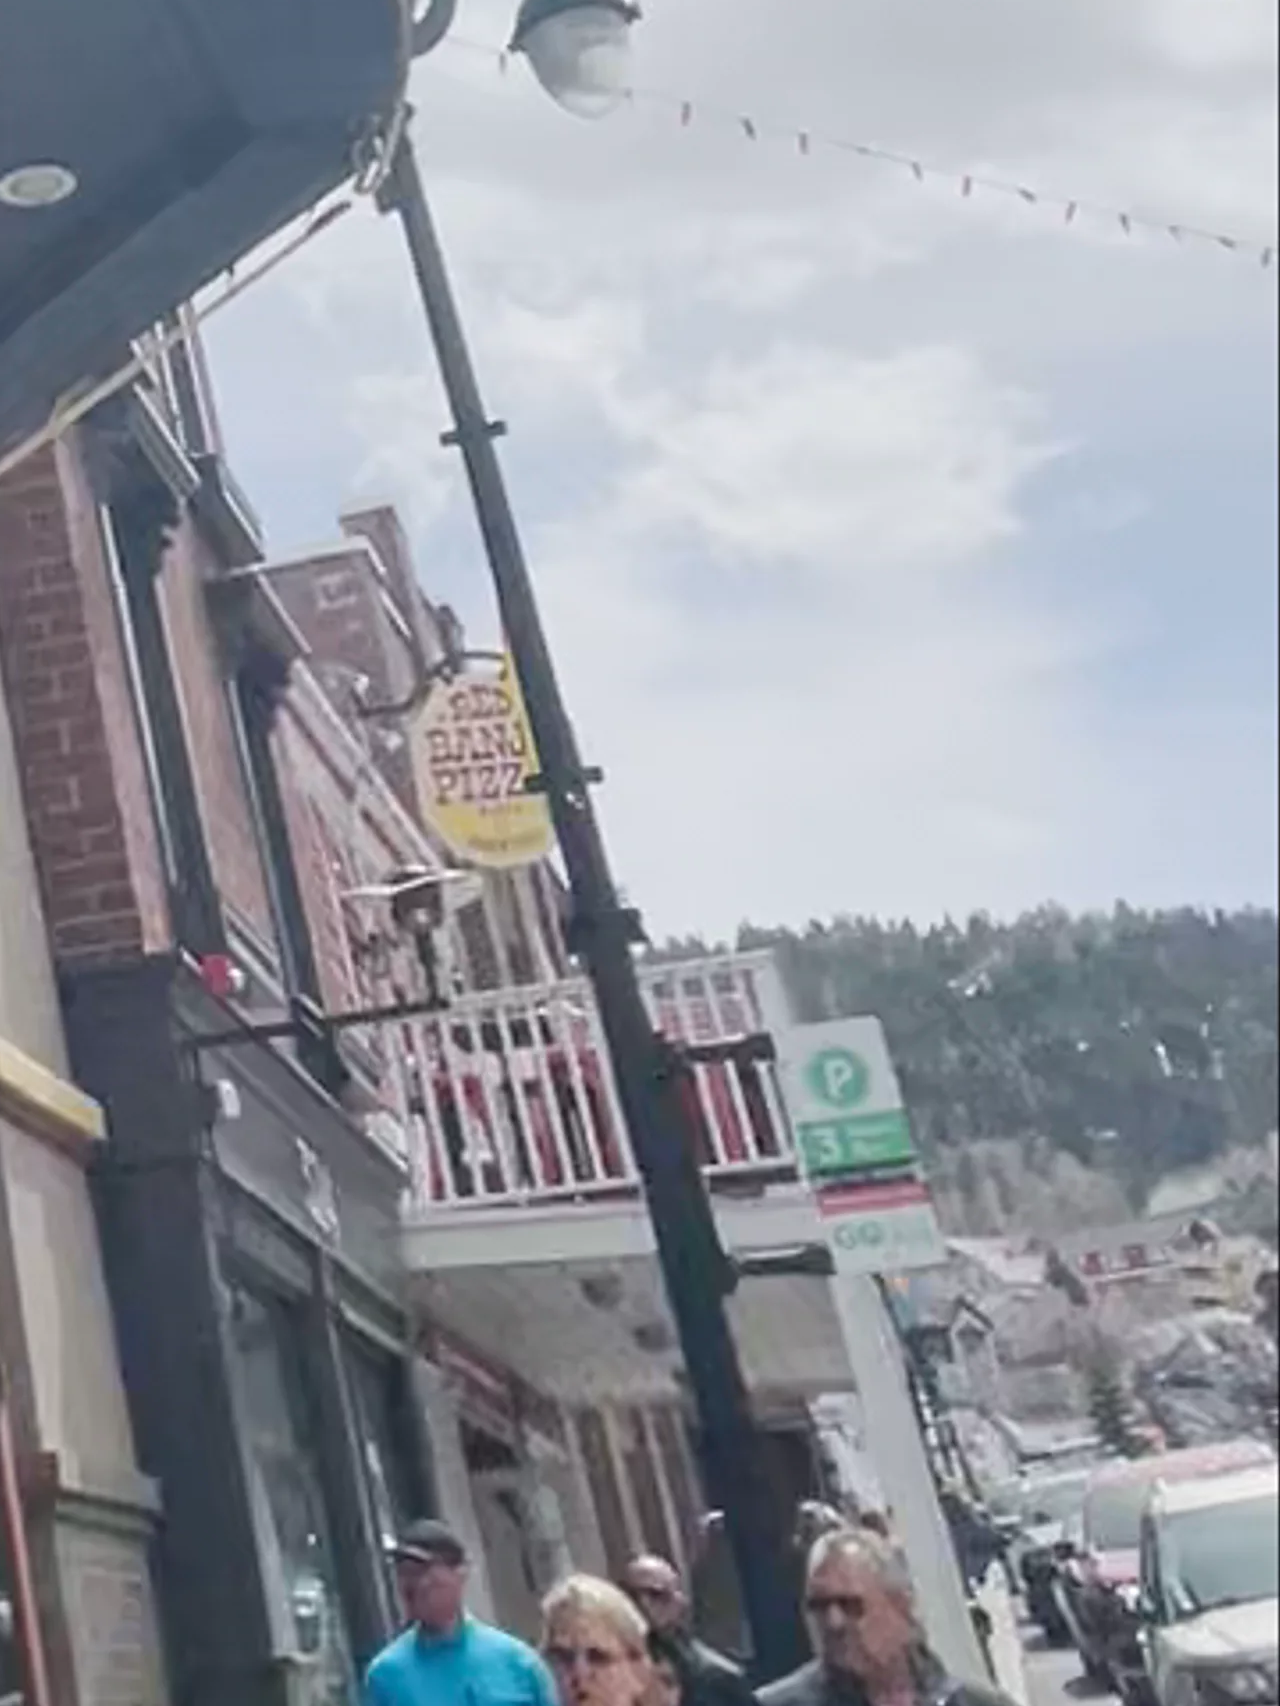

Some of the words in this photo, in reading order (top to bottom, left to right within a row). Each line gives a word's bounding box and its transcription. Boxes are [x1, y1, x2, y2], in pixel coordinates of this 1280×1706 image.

[448, 685, 512, 722] RED
[426, 720, 527, 764] BANJ
[432, 762, 524, 805] PIZZ
